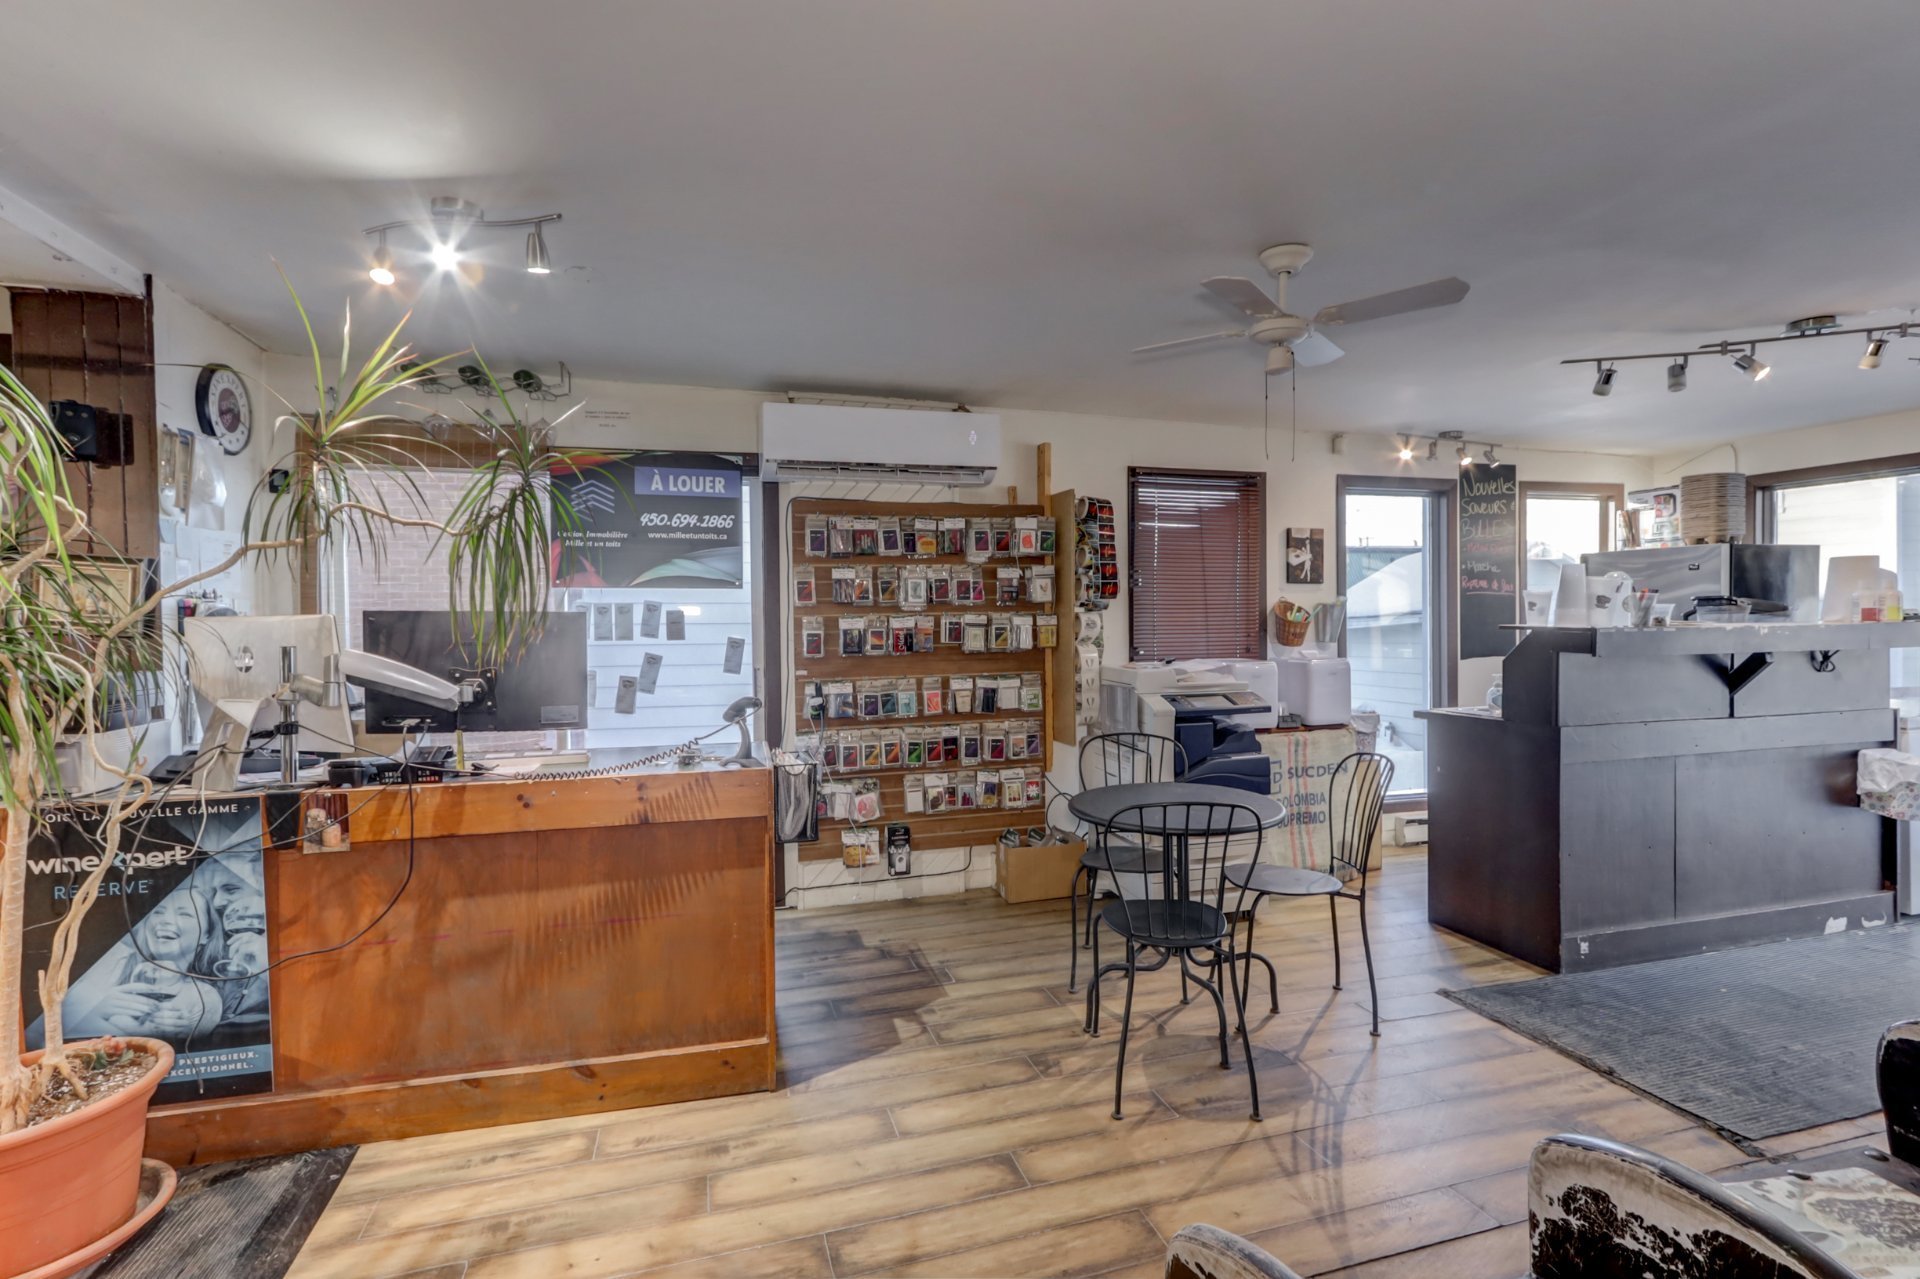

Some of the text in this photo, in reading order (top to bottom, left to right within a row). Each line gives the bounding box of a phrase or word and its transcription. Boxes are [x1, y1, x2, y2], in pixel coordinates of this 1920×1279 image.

[651, 469, 726, 494] À LOUER
[586, 530, 629, 539] Immobilière
[648, 531, 728, 540] www.milleetuntoits.ca
[1287, 763, 1348, 780] SUCDEN
[187, 803, 239, 815] GAMME
[1277, 792, 1327, 809] OLOMBIA
[1278, 811, 1326, 829] UPREMO
[54, 880, 149, 900] REERVE
[165, 1062, 254, 1078] XCEPTIONNEL.
